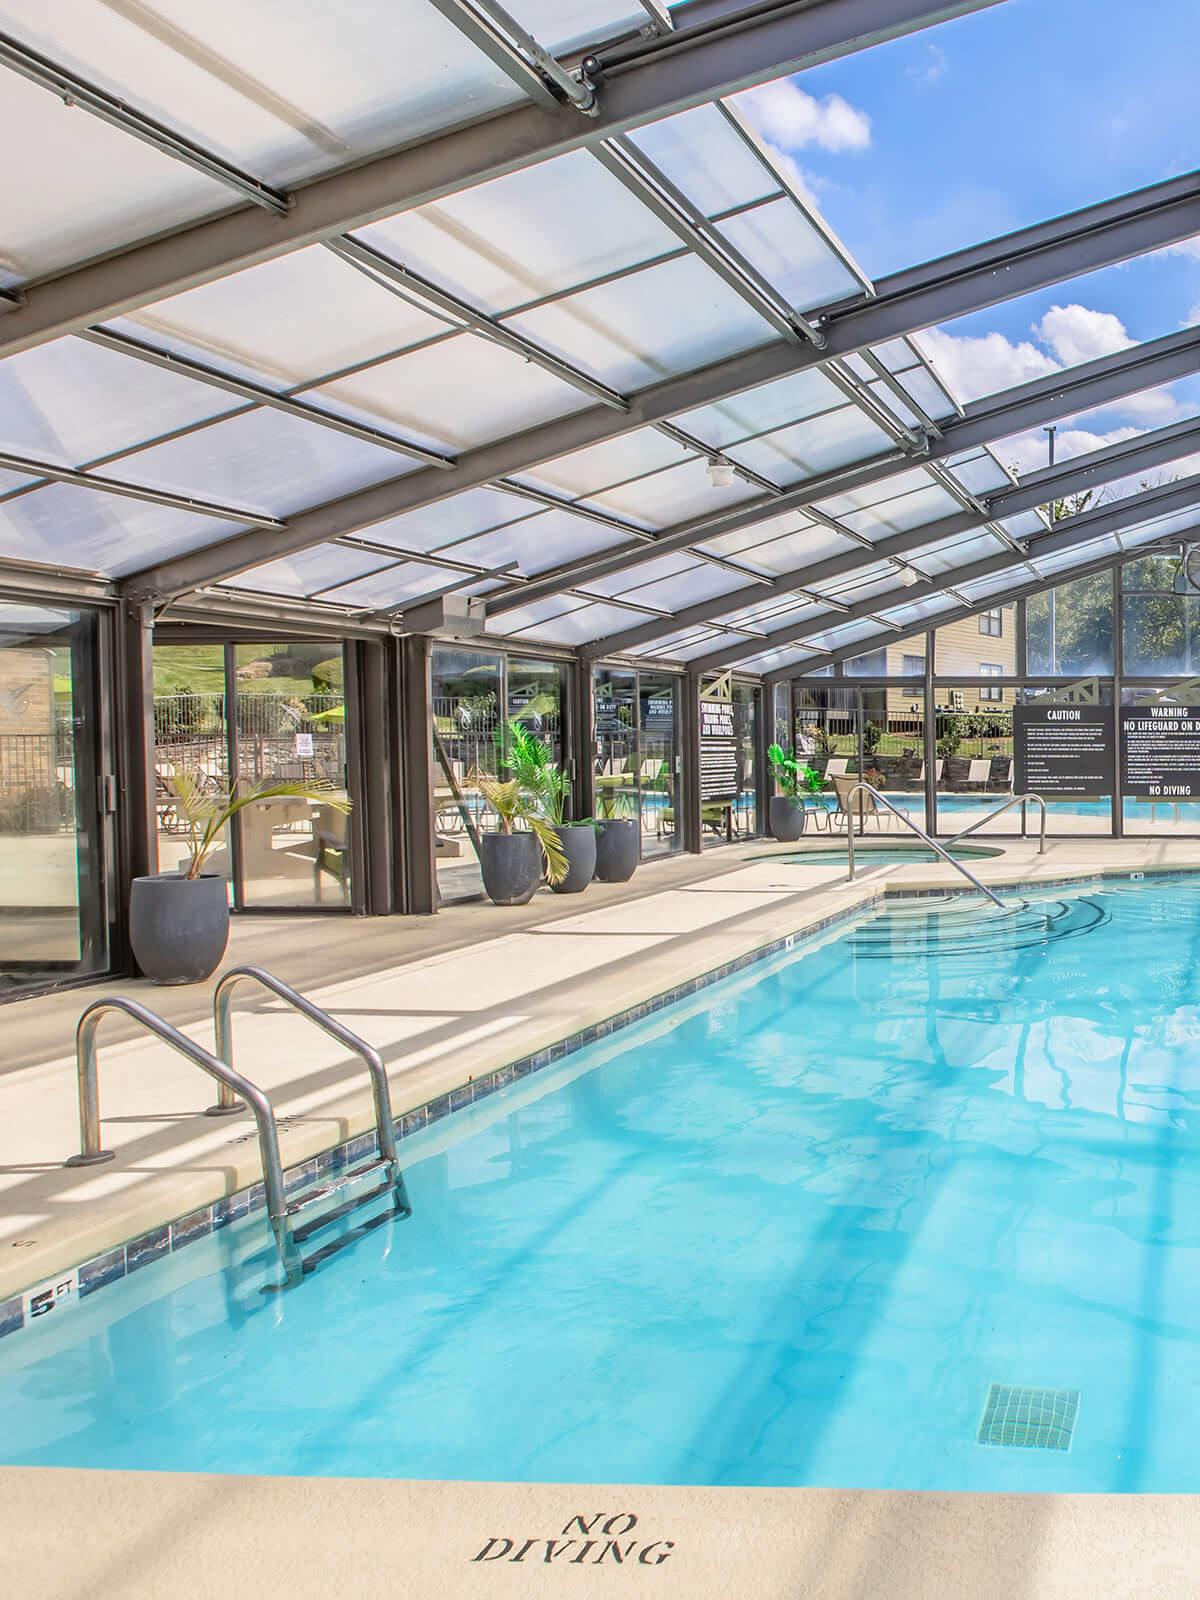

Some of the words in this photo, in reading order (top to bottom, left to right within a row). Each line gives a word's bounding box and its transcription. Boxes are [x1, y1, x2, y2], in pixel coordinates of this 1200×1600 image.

[1047, 710, 1080, 720] CAUTION
[1151, 707, 1188, 717] WARNING
[1124, 721, 1135, 731] NO
[1138, 721, 1178, 731] LIFEGUARD
[1181, 721, 1193, 731] ON
[1149, 785, 1161, 795] NO
[1163, 785, 1191, 795] DIVING
[31, 1289, 56, 1317] 5
[57, 1279, 73, 1296] FT
[561, 1512, 638, 1535] NO
[470, 1538, 675, 1565] DIVING
